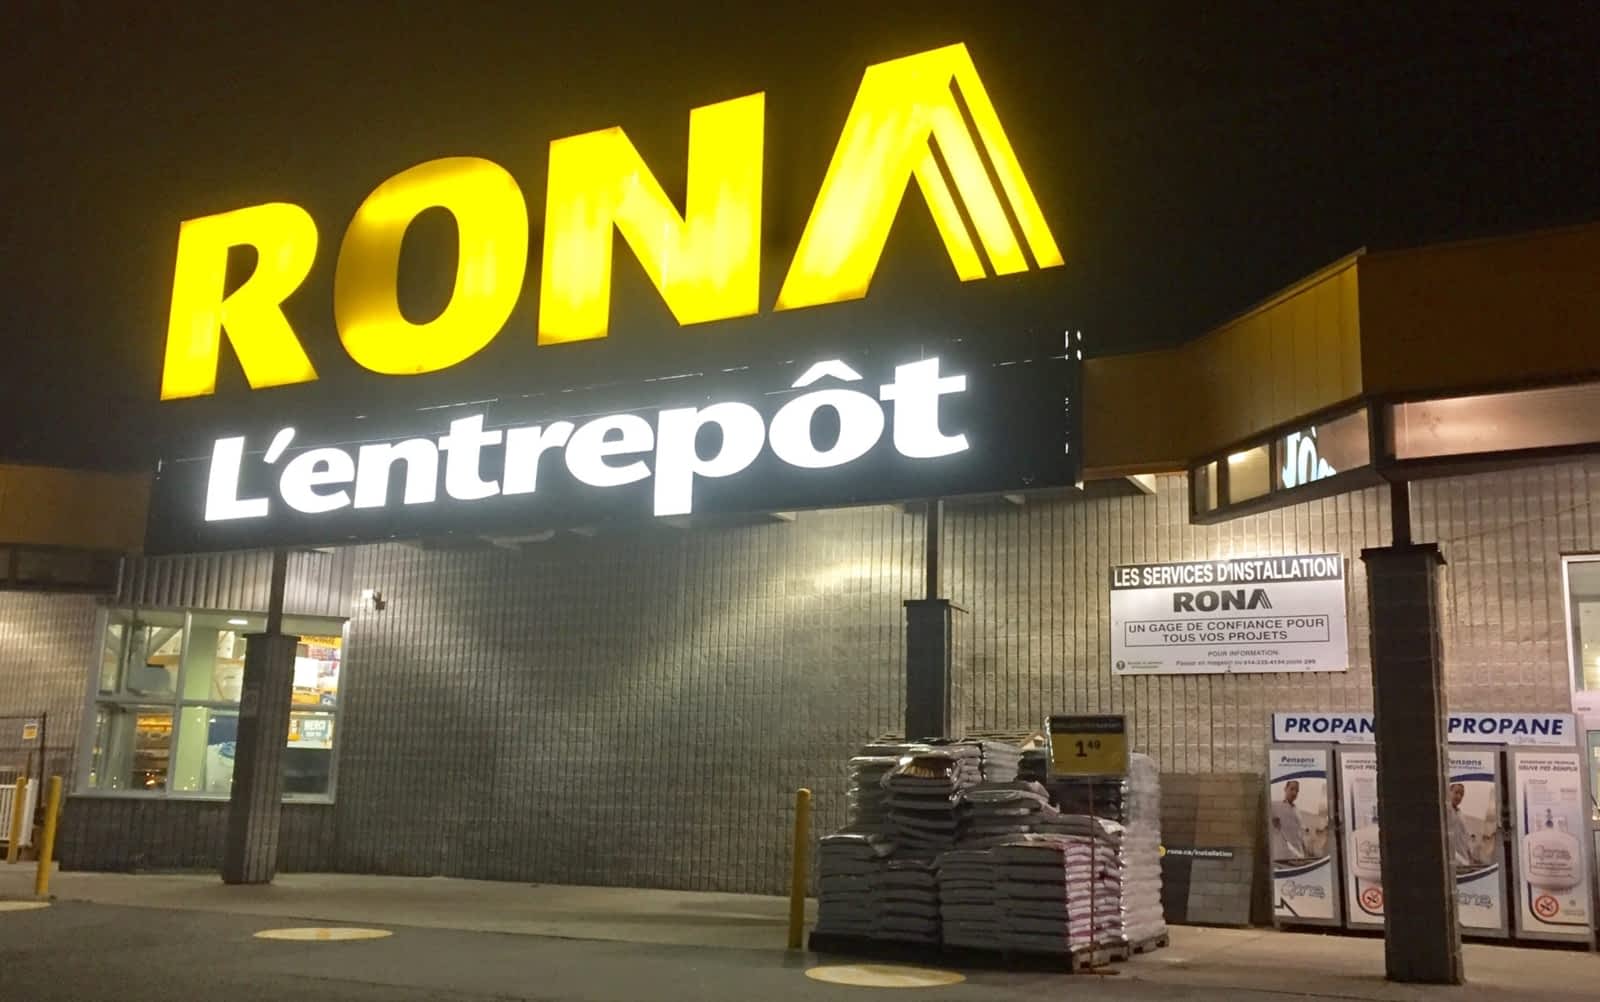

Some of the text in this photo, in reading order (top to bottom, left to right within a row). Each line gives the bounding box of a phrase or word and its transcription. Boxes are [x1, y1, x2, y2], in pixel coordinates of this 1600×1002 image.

[160, 41, 1065, 400] RONA
[204, 356, 969, 517] L'entrepôt
[1114, 557, 1338, 587] LES SERVICES D'INSTALLATION
[1173, 588, 1272, 612] RONA
[1129, 618, 1325, 633] UN GAGE DE CONFIANCE POUR
[1163, 630, 1288, 643] TOUS VOS PROJETS
[1285, 717, 1375, 734] PROPAN
[1448, 717, 1564, 736] PROPANE
[1448, 759, 1482, 767] ensons
